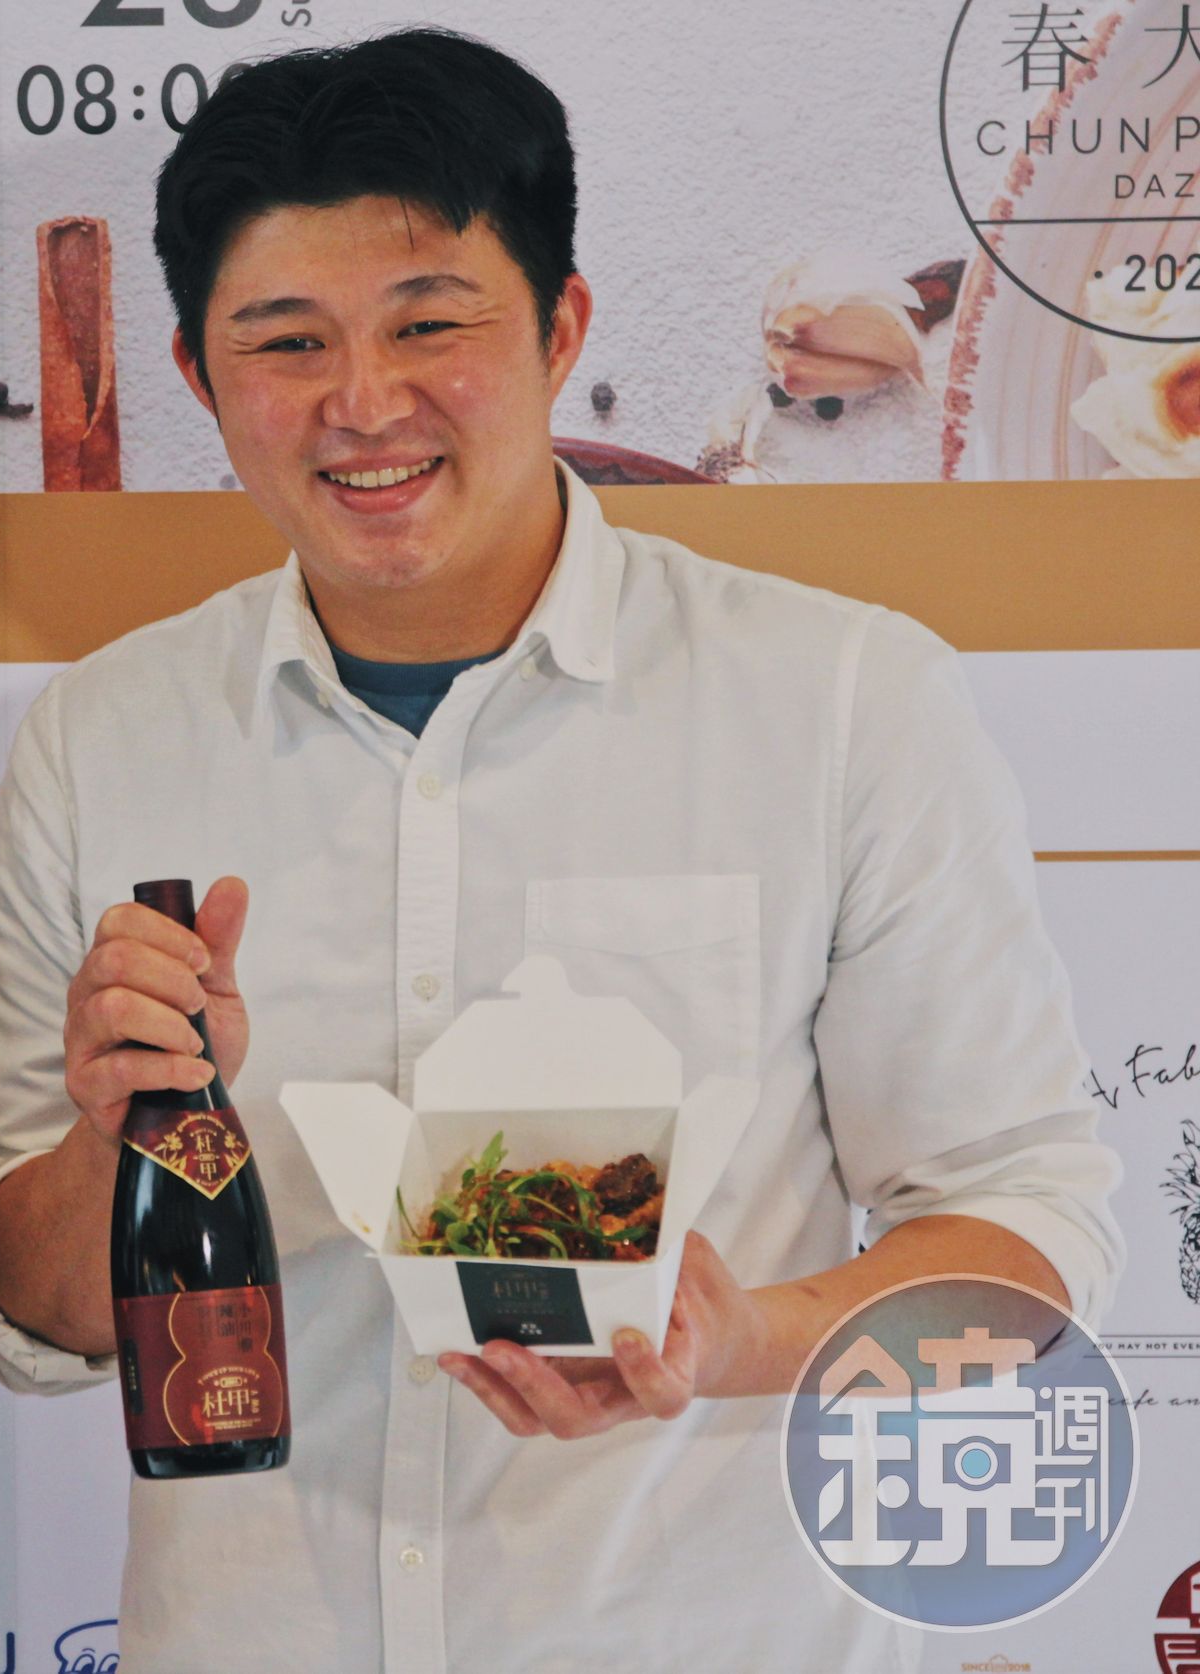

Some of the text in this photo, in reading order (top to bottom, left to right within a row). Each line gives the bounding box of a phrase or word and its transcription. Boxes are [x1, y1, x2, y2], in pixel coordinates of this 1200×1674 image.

[16, 63, 253, 136] 08:0
[1114, 173, 1195, 200] DAZ
[1118, 1343, 1141, 1351] MAY
[1146, 1343, 1167, 1351] NOT
